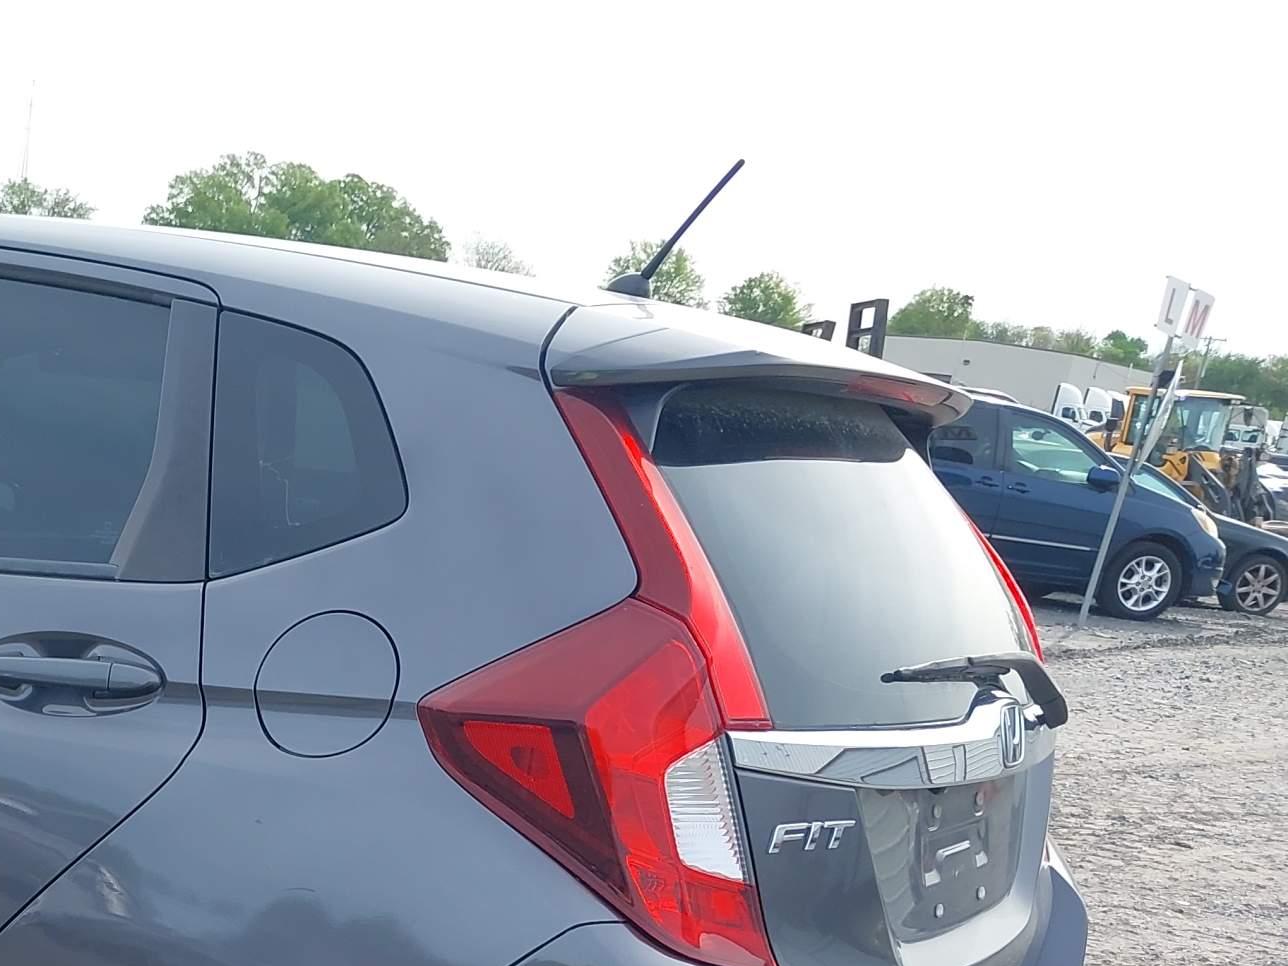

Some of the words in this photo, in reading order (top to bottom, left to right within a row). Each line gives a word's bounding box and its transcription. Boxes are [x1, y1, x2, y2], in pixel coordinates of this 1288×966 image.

[1164, 287, 1176, 325] L
[1184, 299, 1210, 338] M
[768, 820, 856, 854] FIT
